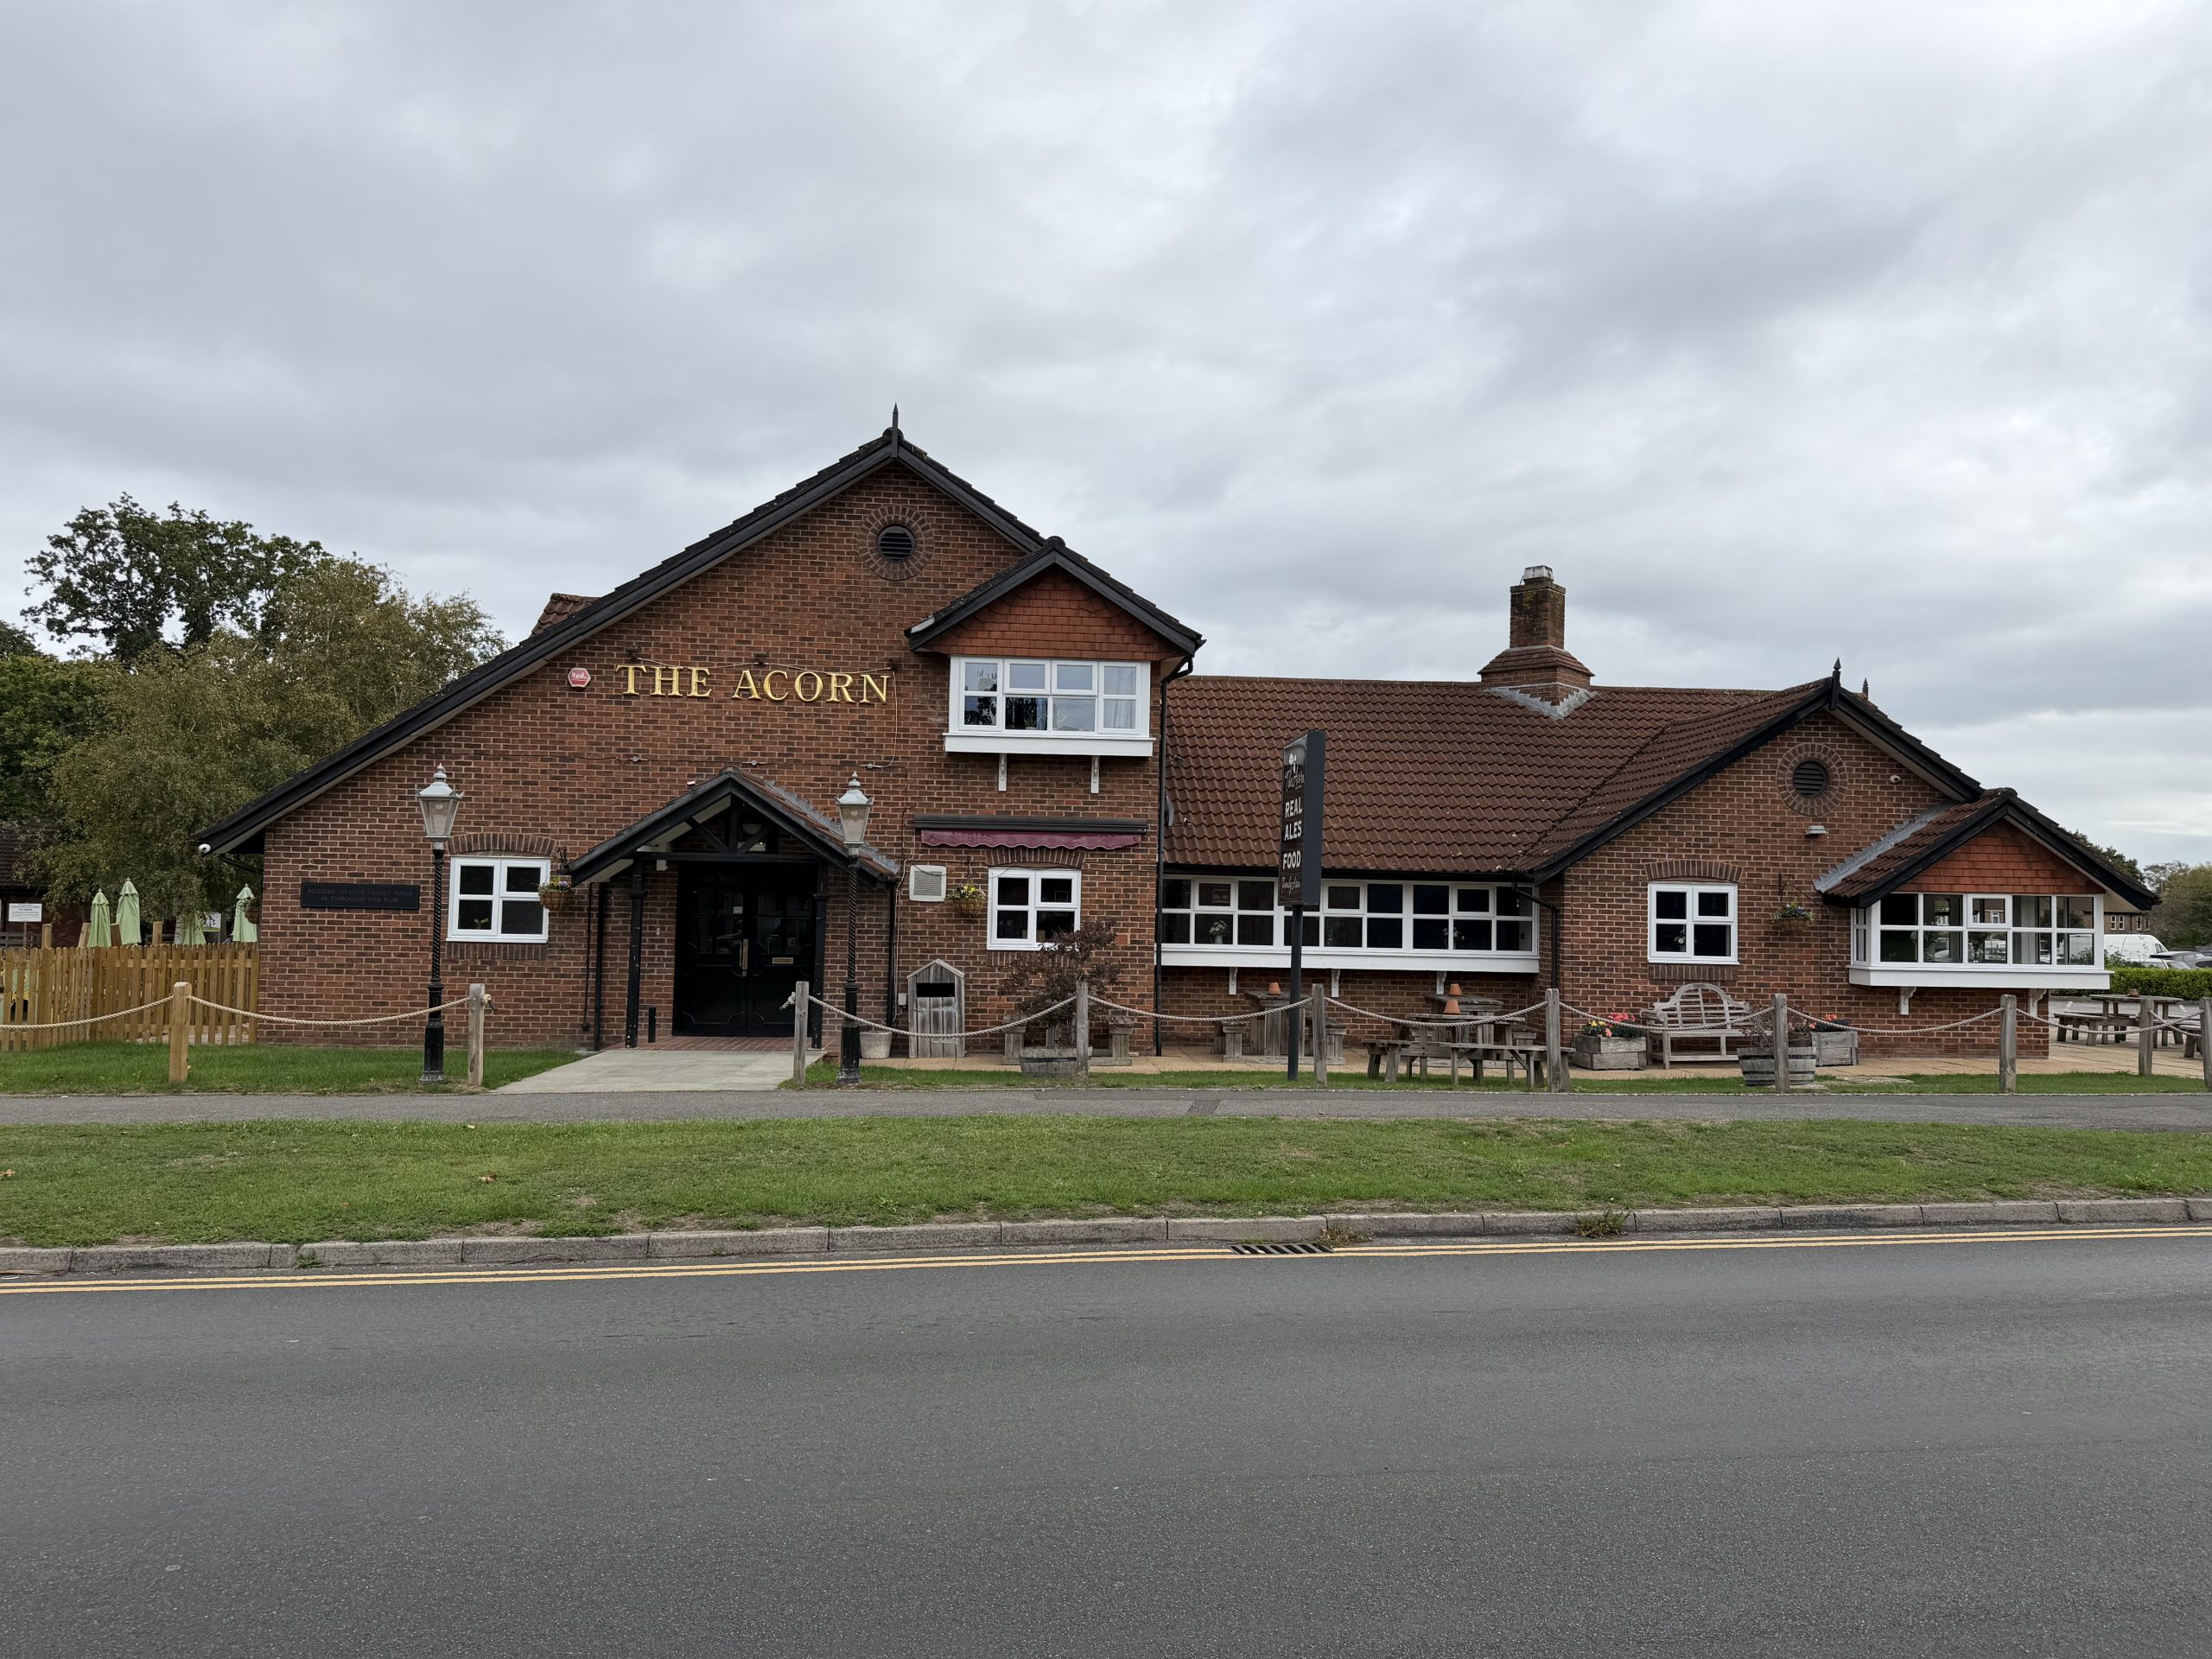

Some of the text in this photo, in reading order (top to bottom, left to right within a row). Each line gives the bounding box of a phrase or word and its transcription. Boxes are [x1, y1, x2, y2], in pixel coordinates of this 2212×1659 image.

[615, 664, 890, 704] THE ACORN
[1285, 797, 1302, 818] REAL
[1284, 821, 1302, 842] ALES
[1282, 850, 1301, 870] FOOD
